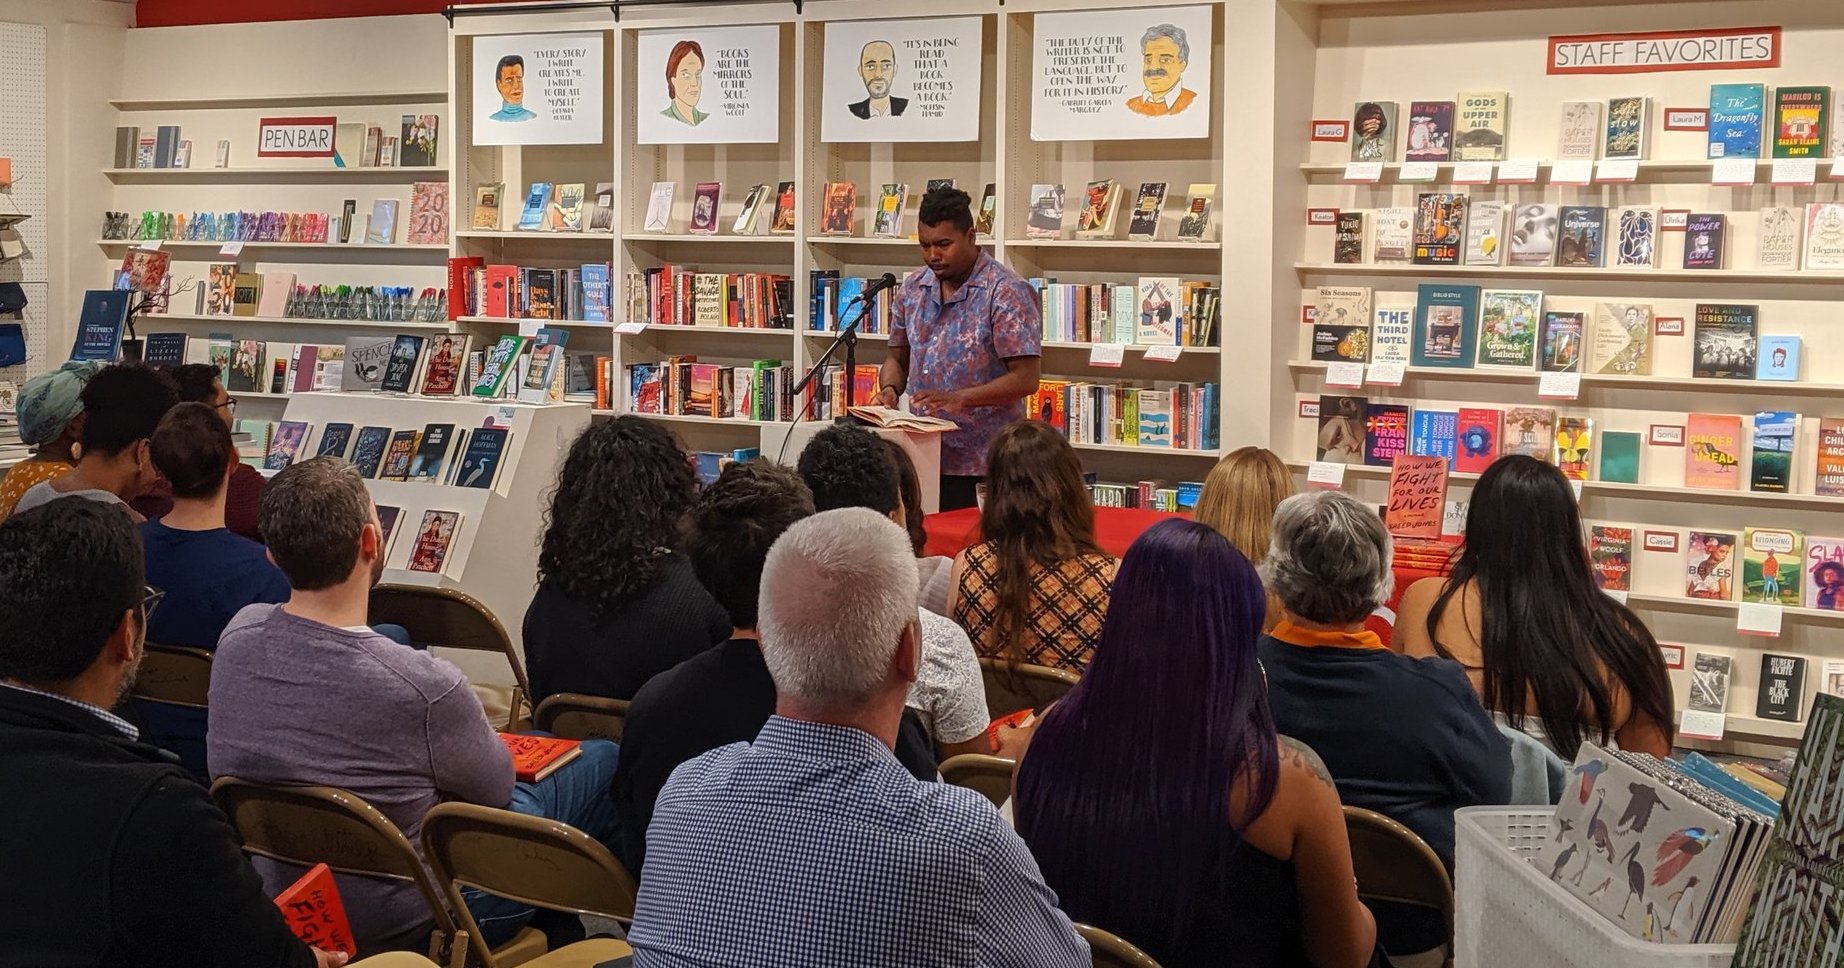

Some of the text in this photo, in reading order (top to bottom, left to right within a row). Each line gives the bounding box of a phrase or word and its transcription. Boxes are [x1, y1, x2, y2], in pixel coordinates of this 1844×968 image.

[923, 37, 960, 48] IN BEING
[1068, 37, 1093, 46] DUTY
[1107, 36, 1123, 45] THE
[562, 48, 587, 58] STORY
[919, 49, 945, 59] READ
[1046, 44, 1126, 56] WRITER IS NOT TO
[1556, 36, 1770, 66] STAFF FAVORITES
[552, 59, 574, 67] WRITE
[717, 59, 749, 69] ARE THE
[913, 59, 948, 69] THAT A
[1053, 55, 1115, 65] PRESERVE THE
[1095, 64, 1111, 73] BUT
[1116, 63, 1128, 73] TO
[538, 69, 571, 78] CREATES
[712, 69, 753, 79] MIRRORS
[920, 70, 943, 80] BOOK
[552, 79, 573, 87] WRITE
[720, 80, 745, 89] OF THE
[1050, 75, 1117, 86] OPEN THE WAY
[913, 81, 953, 91] BECOMES
[544, 88, 580, 97] TO CREATE
[1044, 87, 1084, 97] FOR IT IN
[1814, 92, 1822, 101] IS
[1465, 98, 1497, 107] GODS
[1727, 98, 1746, 108] The
[725, 109, 745, 117] WOOLF
[921, 110, 944, 118] HAMID
[1462, 111, 1498, 119] UPPER
[1672, 114, 1702, 123] Laura M
[1712, 112, 1759, 126] Dragonfly
[1469, 120, 1489, 128] AIR
[1317, 127, 1343, 136] Laura G
[1726, 128, 1744, 138] Sea
[264, 128, 329, 148] PEN BAR
[1788, 146, 1809, 155] SMITH
[419, 192, 444, 213] 20
[416, 214, 442, 234] 20
[1564, 220, 1600, 229] Universe
[1687, 222, 1721, 232] POWER
[1417, 245, 1456, 258] music
[1688, 249, 1715, 260] CUTE
[704, 275, 720, 285] THE
[694, 285, 720, 296] SAVAGE
[1320, 289, 1362, 297] Six Seasons
[1697, 306, 1720, 314] LOVE
[1378, 310, 1409, 325] THE
[1697, 314, 1752, 324] RESISTANCE
[86, 326, 114, 334] STEPHEN
[1377, 325, 1409, 335] THIRD
[1659, 321, 1680, 330] Alana
[84, 332, 112, 343] KING
[1376, 335, 1408, 345] HOTEL
[1486, 340, 1513, 352] Grown
[1039, 383, 1057, 392] FOR
[1055, 383, 1064, 413] LIARS
[1303, 405, 1319, 413] Traci
[1375, 428, 1405, 438] FRAN
[1656, 428, 1680, 438] Sonia
[1377, 437, 1405, 448] KISS
[1689, 434, 1734, 447] GINGER
[1373, 449, 1405, 459] STEIN
[1397, 461, 1443, 472] HOW WE
[1392, 472, 1444, 489] FIGHT
[1392, 486, 1442, 498] FOR OUR
[1093, 487, 1122, 508] HARD
[1389, 497, 1440, 512] LIVES
[1412, 520, 1438, 529] JONES
[1595, 536, 1630, 547] VIRGINIA
[1648, 536, 1673, 548] Cassie
[1599, 546, 1624, 555] WOOLF
[1594, 563, 1628, 574] ORLANDO
[1773, 680, 1788, 689] THE
[1767, 687, 1790, 698] BLACK
[1769, 696, 1786, 705] CITY
